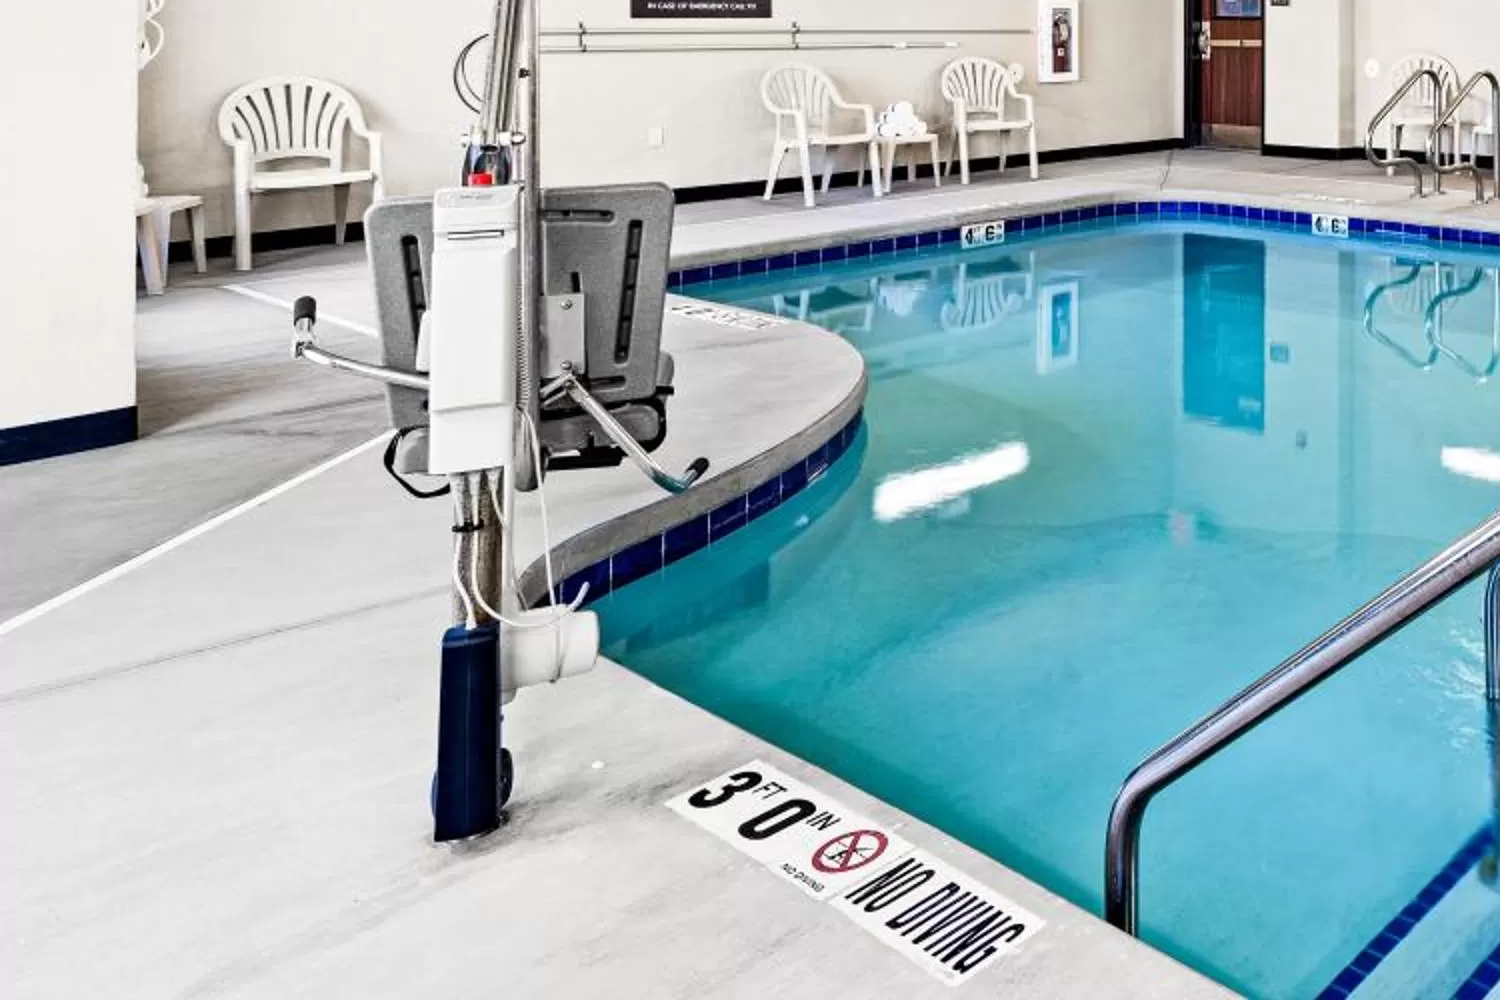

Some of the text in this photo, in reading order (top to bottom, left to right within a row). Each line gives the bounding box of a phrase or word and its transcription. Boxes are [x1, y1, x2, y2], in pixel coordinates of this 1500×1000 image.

[688, 771, 841, 841] 3 FT 0 IN
[844, 856, 1026, 974] NO DIVING
